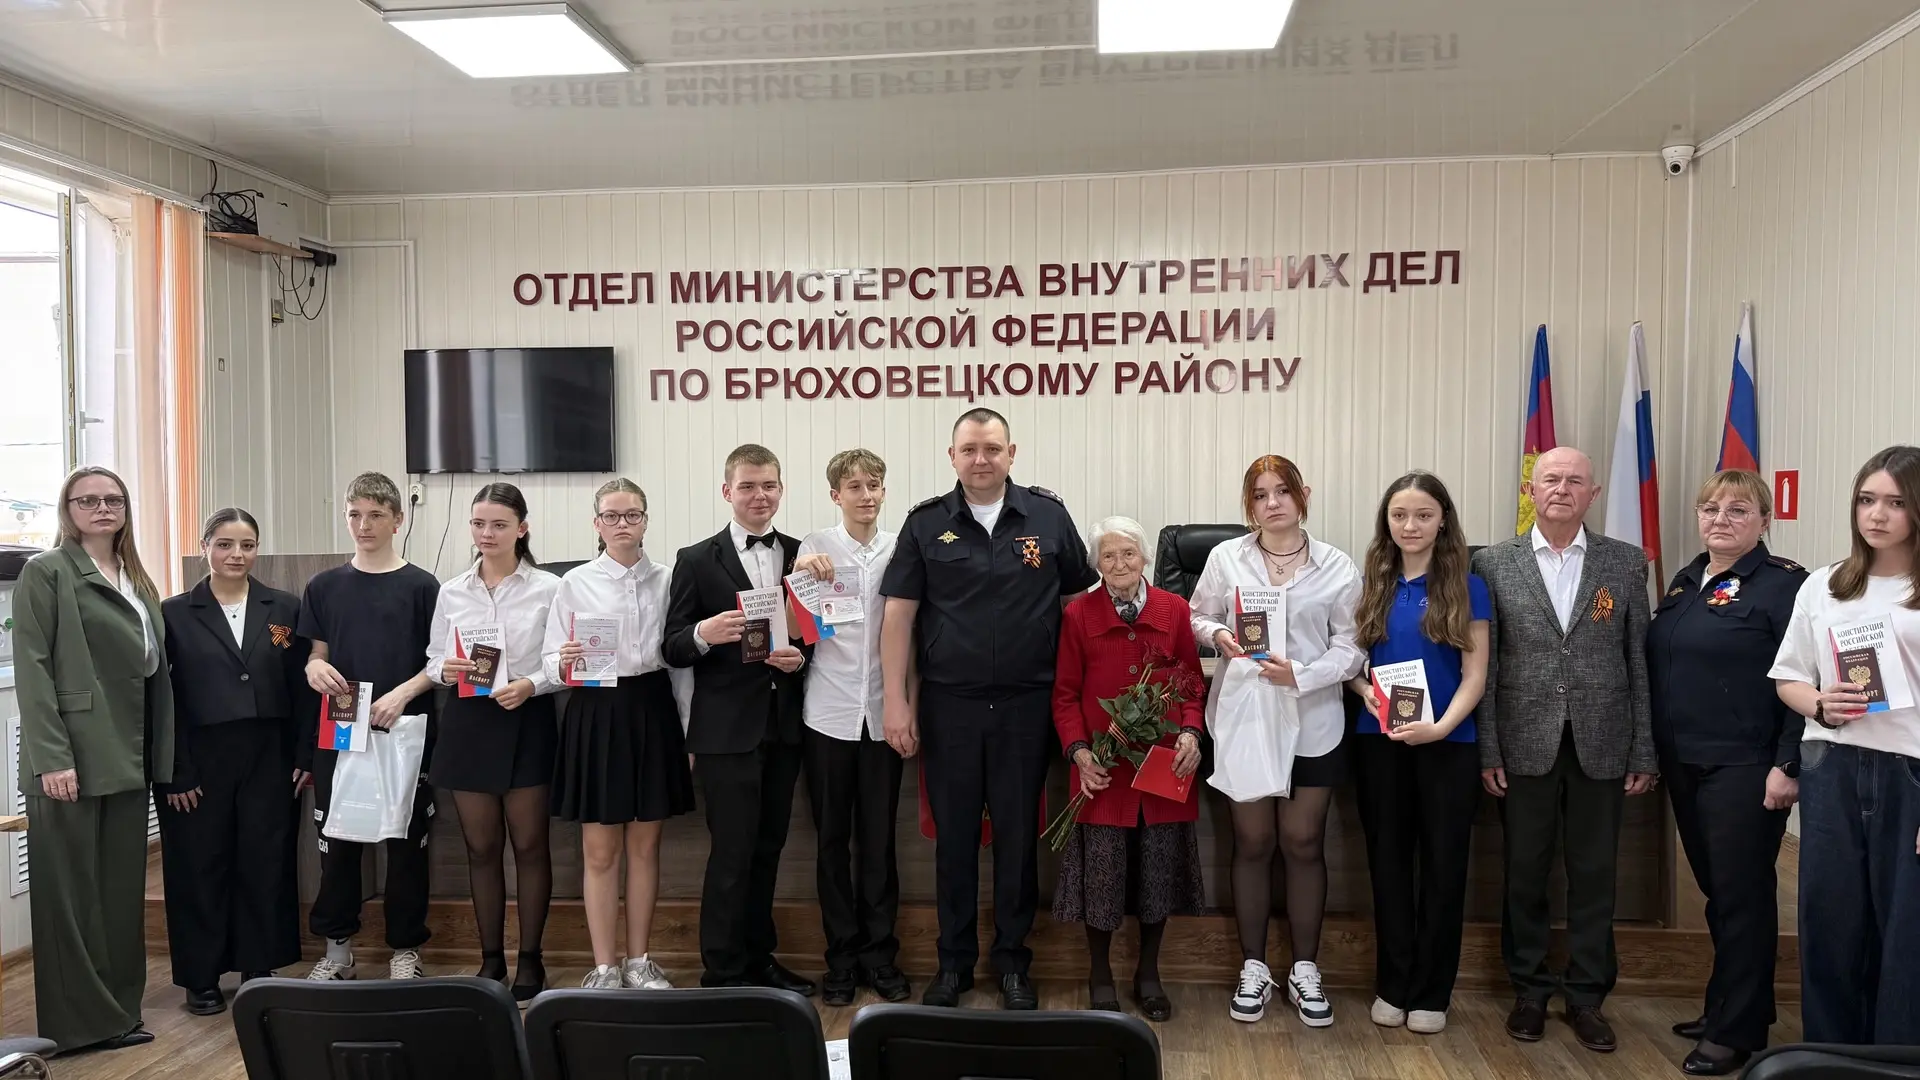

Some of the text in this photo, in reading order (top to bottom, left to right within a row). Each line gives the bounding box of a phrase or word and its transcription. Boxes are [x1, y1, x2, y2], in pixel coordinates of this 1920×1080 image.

[513, 250, 1460, 311] ОТДЕЛ МИНИСТЕРСТВА ВНУТРЕННИХ ДЕЛ
[675, 307, 1275, 353] РОССИЙСКОЙ ФЕДЕРАЦИИ
[650, 353, 1301, 403] ПО БРЮХОВЕЦКОМУ РАЙОНУ
[743, 592, 778, 602] КОНСТИТУЦИЯ
[745, 599, 777, 609] РОССИЙСКОЙ
[461, 628, 499, 636] КОНСТИТУЦИЯ
[1837, 622, 1884, 638] КОНСТИТУЦИЯ
[463, 634, 498, 643] РОССИЙСКОЙ
[1840, 630, 1884, 647] РОССИЙСКОЙ
[1377, 665, 1417, 676] КОНСТИТУЦИЯ
[469, 675, 490, 684] ПАСПОРТ
[1380, 671, 1417, 682] РОССИЙСКОЙ
